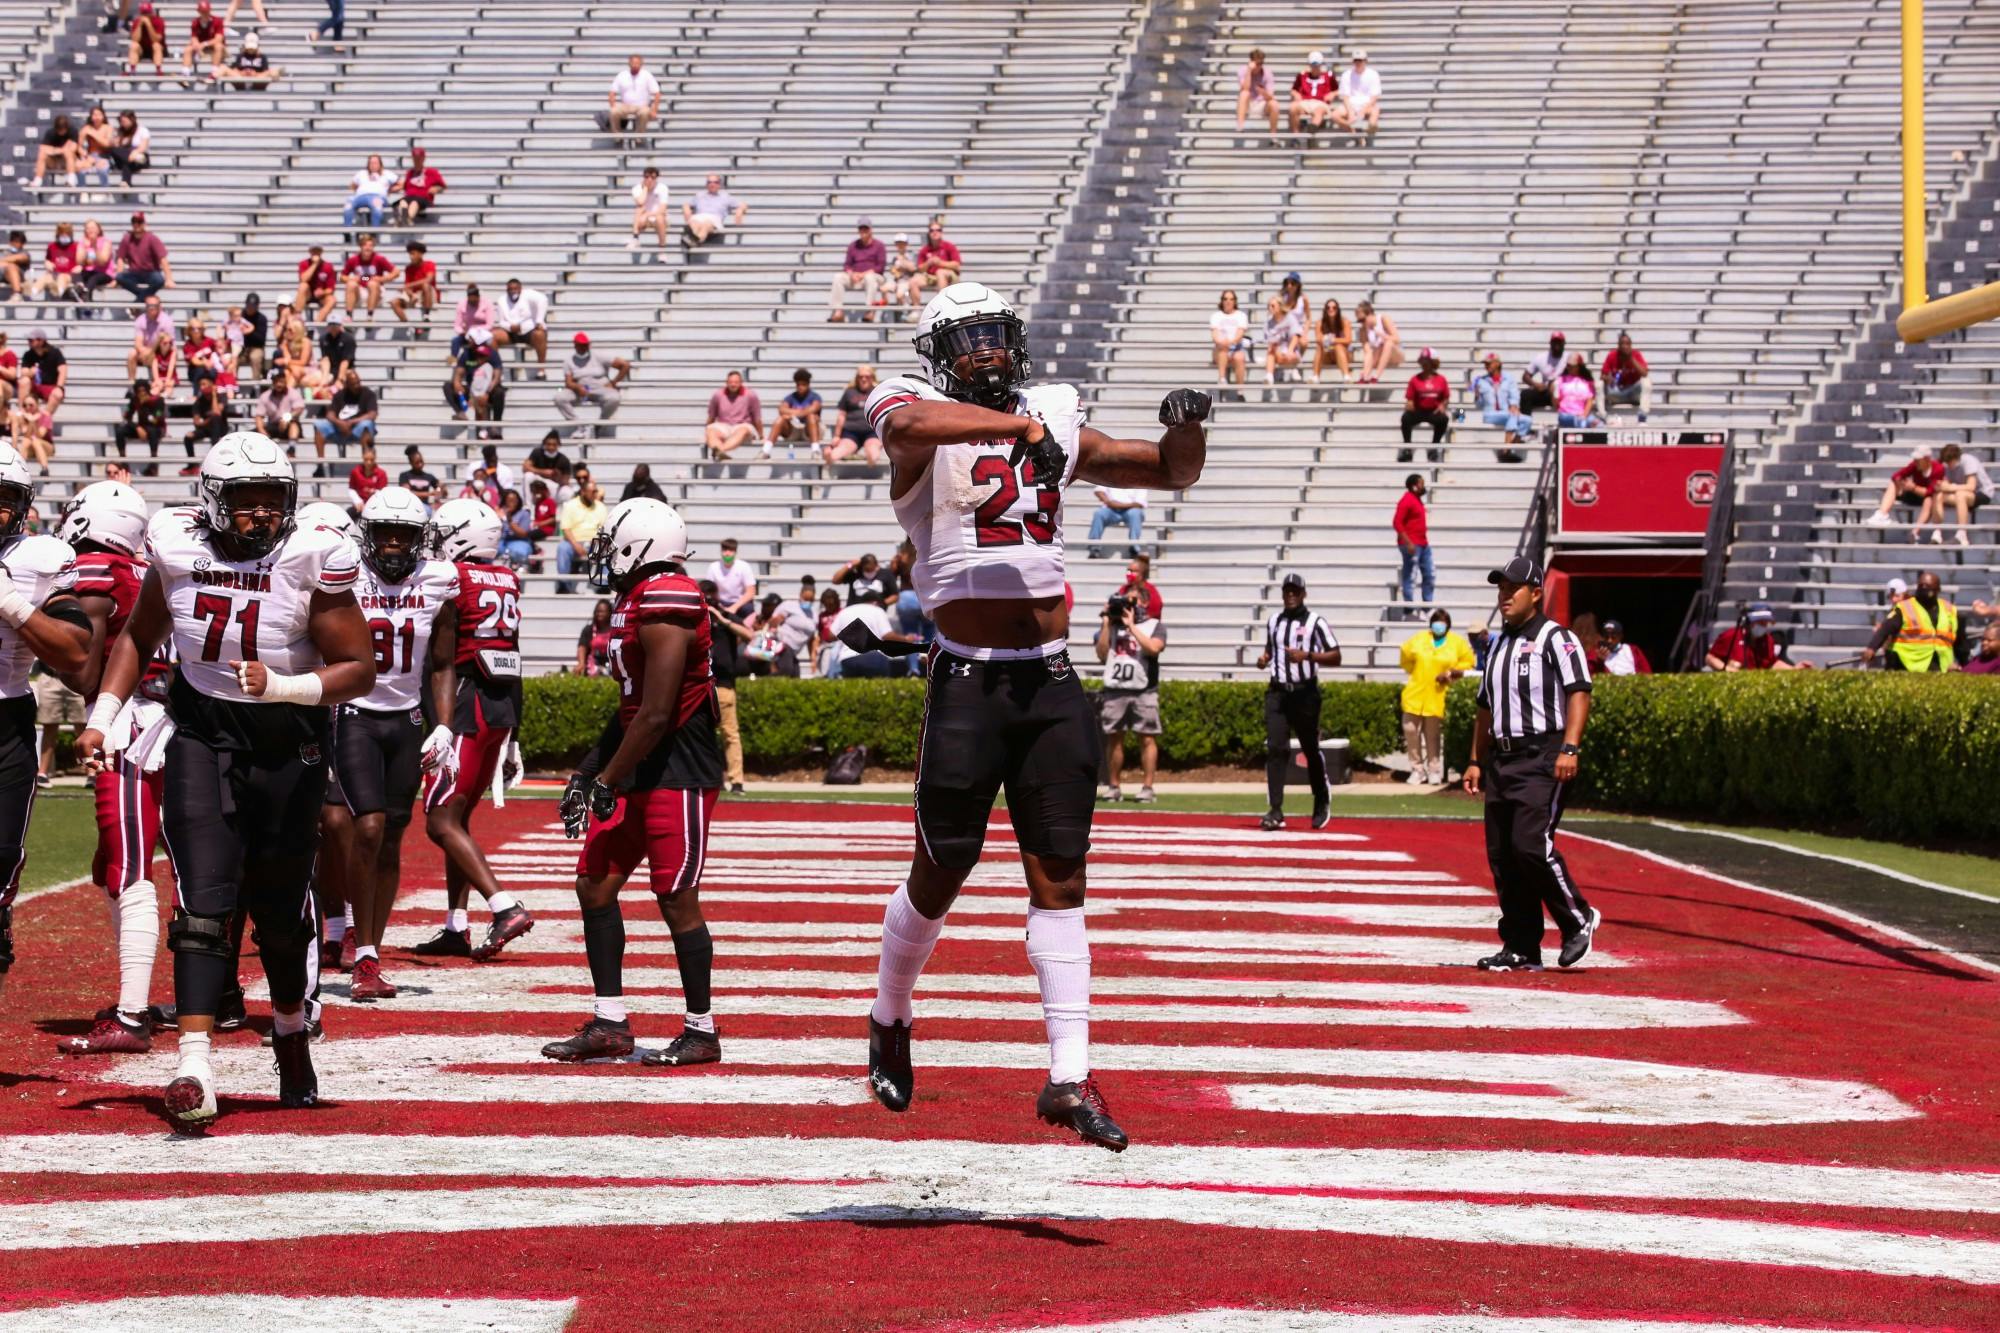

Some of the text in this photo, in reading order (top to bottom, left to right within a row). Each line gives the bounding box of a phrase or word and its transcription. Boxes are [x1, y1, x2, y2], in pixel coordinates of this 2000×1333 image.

[1607, 431, 1663, 445] SECTION
[970, 455, 1061, 548] 23
[1770, 546, 1776, 558] 7
[192, 570, 271, 592] CAROLINA
[361, 595, 425, 609] CAROLINA
[193, 591, 261, 662] 71
[1112, 663, 1134, 681] 20
[1519, 662, 1529, 677] B
